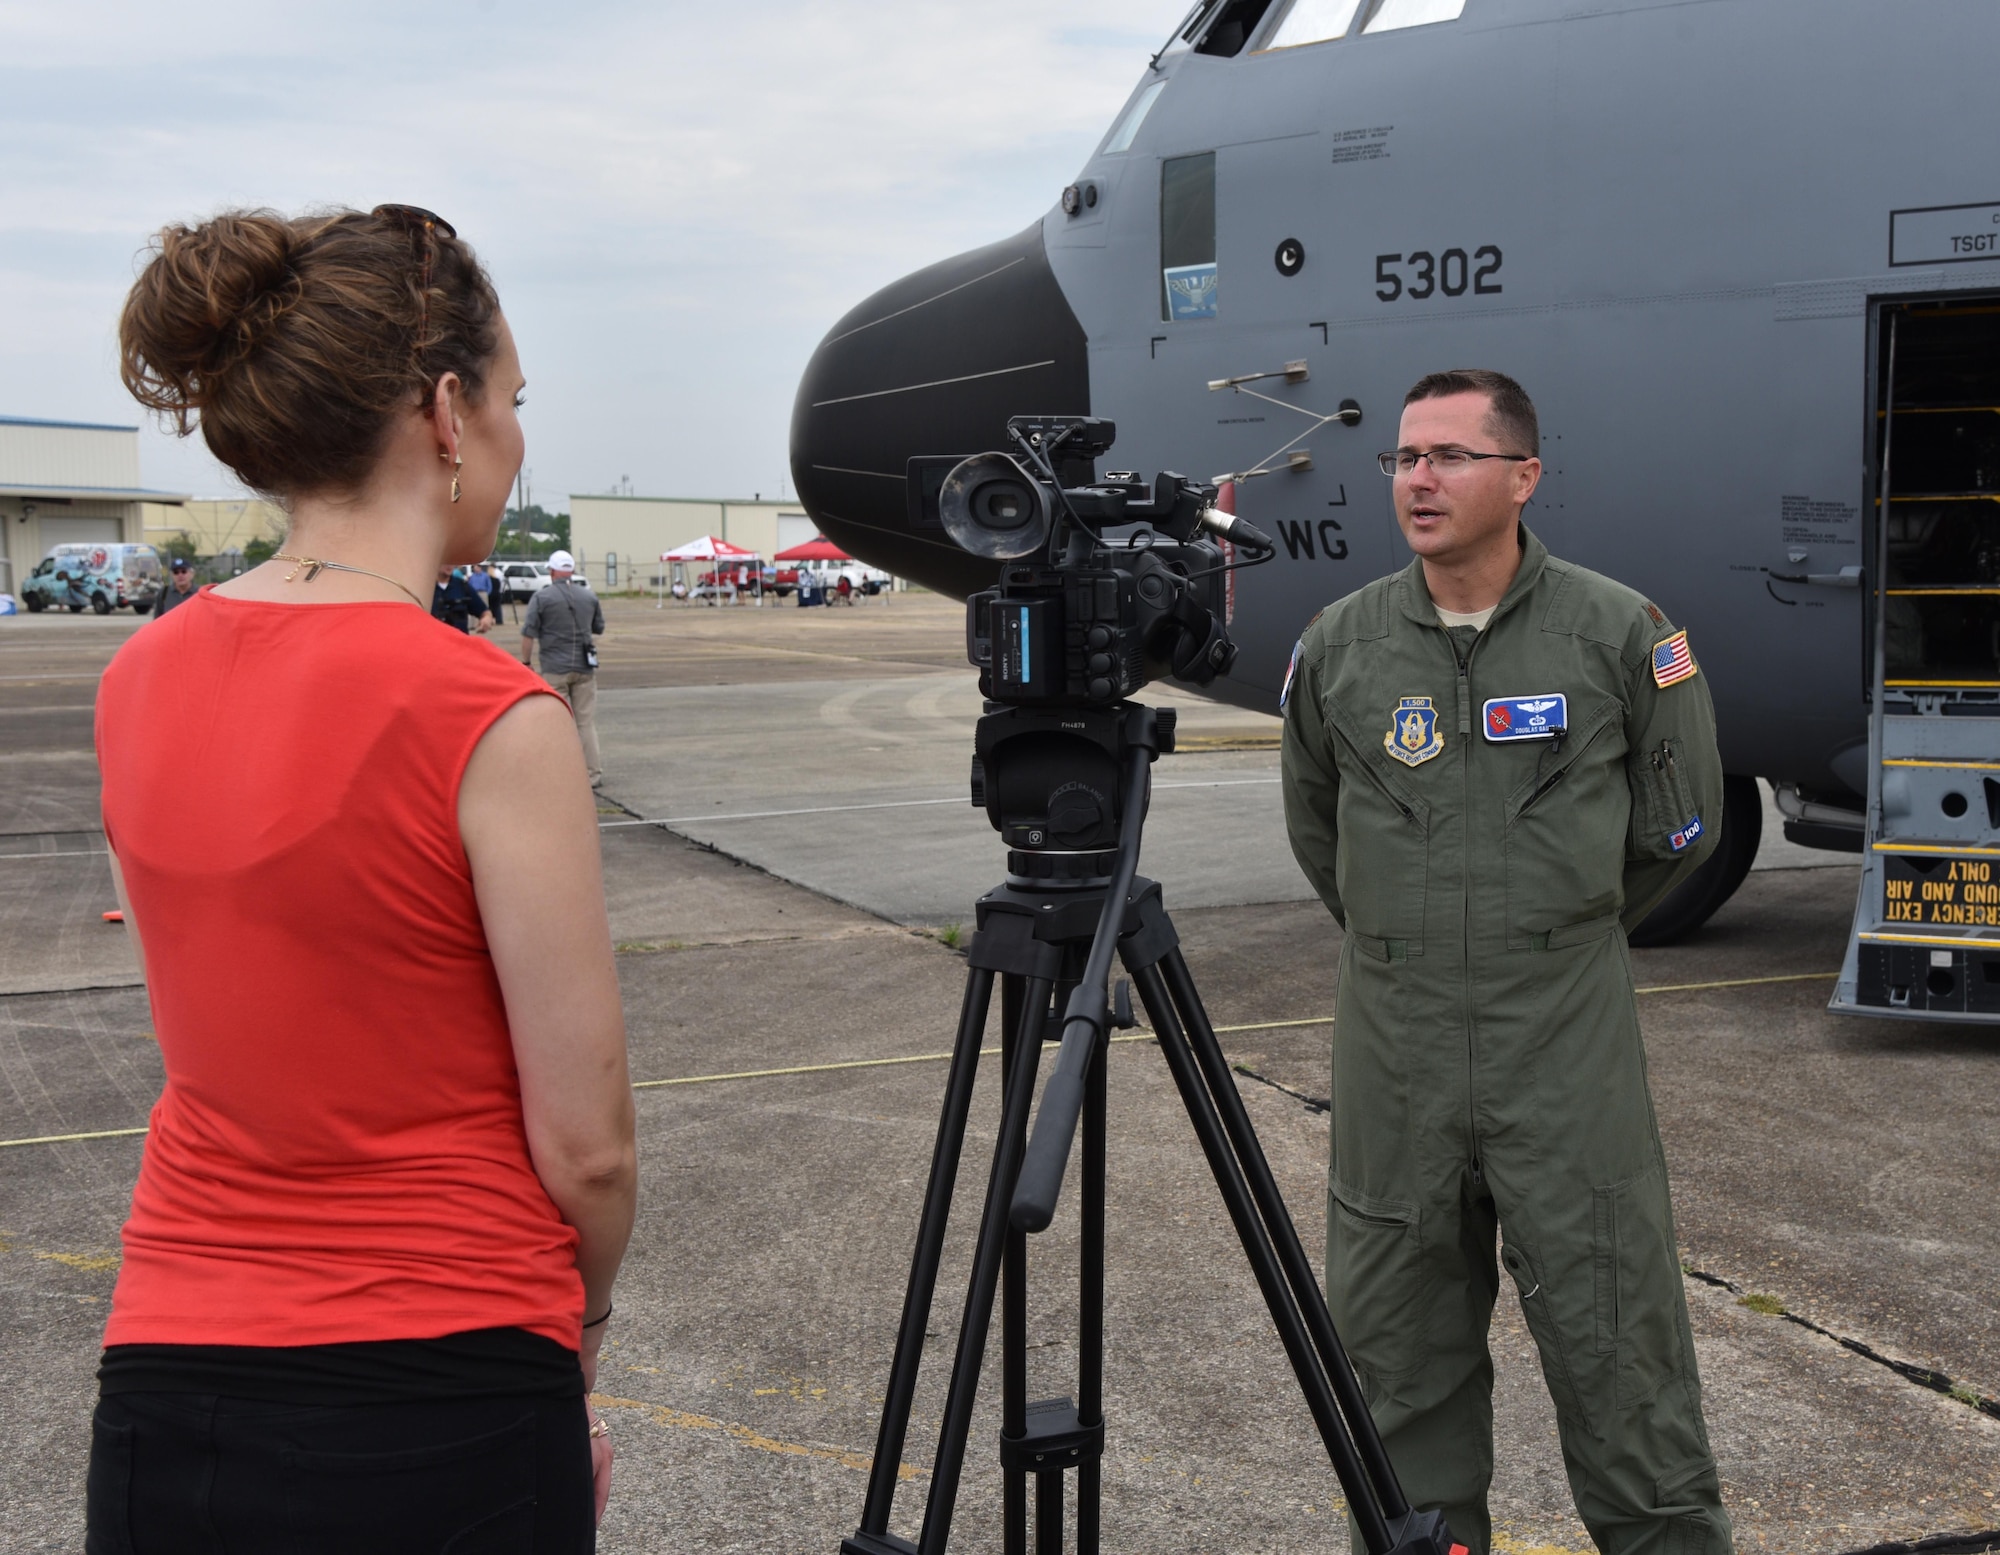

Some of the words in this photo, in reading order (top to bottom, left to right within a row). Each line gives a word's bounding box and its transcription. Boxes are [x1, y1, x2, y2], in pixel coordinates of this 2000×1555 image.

[1951, 233, 1998, 253] TSGT
[1376, 245, 1502, 302] 5302
[1276, 520, 1349, 560] WG
[1515, 726, 1538, 734] DOUGLAS
[1684, 822, 1700, 840] 100
[1948, 861, 1990, 882] ONLY
[1886, 879, 1914, 900] AIR
[1921, 881, 1955, 902] AND
[1886, 901, 1923, 921] EXIT
